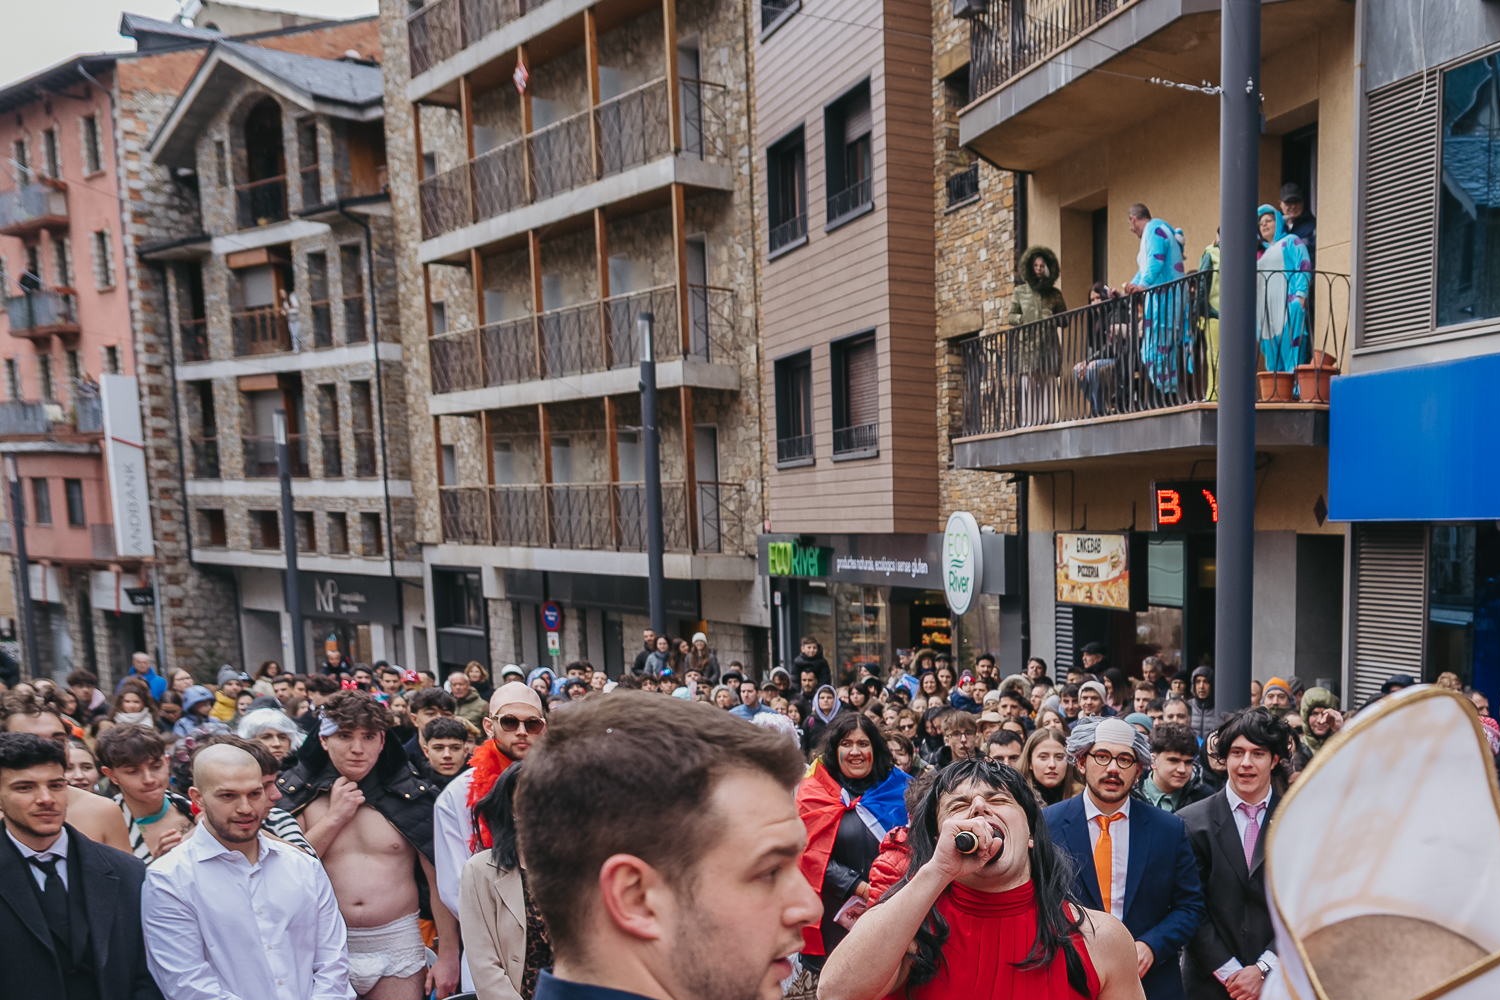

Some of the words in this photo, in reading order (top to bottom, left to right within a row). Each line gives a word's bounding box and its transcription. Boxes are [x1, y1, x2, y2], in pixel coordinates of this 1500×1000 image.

[122, 461, 144, 553] ANDBANK
[948, 533, 970, 557] ECO
[911, 557, 928, 578] gluten
[1078, 565, 1100, 578] PIZZERIA
[949, 570, 970, 593] River
